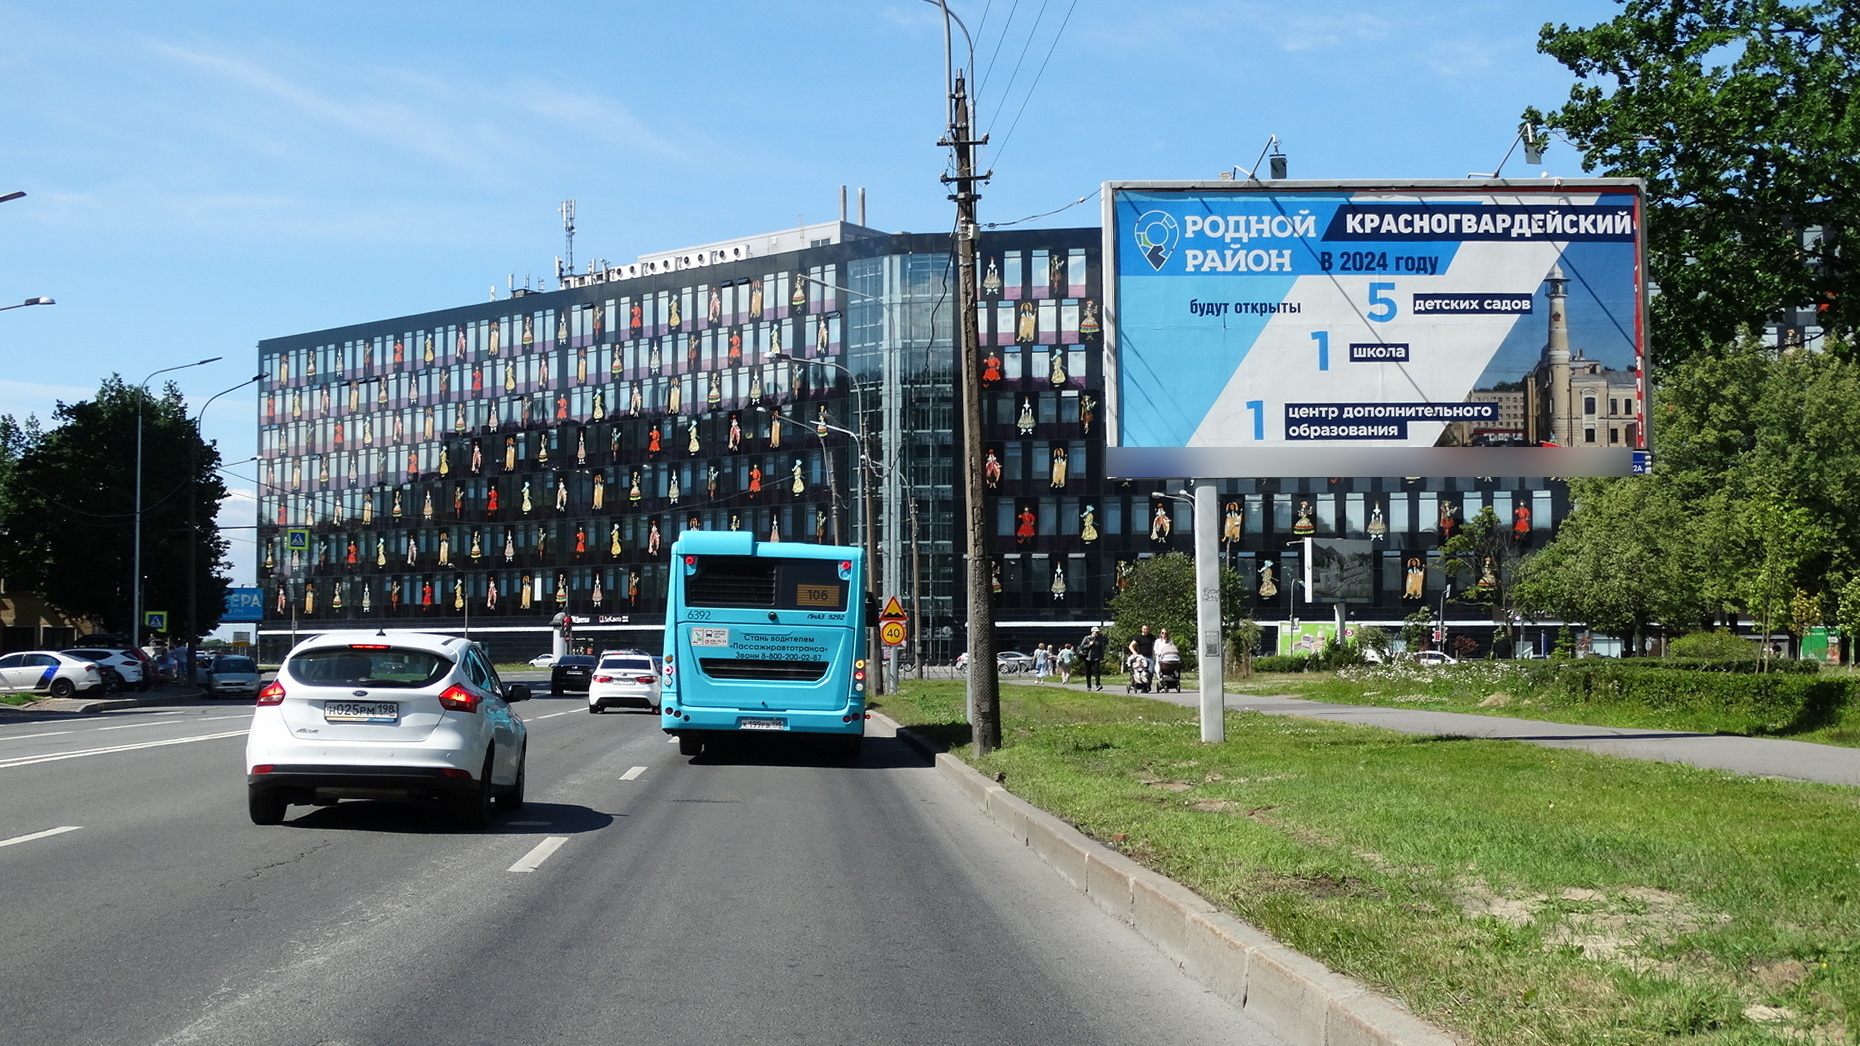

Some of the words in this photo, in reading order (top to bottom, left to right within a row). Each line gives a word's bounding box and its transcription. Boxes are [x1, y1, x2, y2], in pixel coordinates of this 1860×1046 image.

[1184, 209, 1316, 243] РОДНОЙ
[1346, 211, 1631, 237] КРАСНОГВАРДЕЙСКИЙ
[1185, 243, 1292, 272] РАЙОН
[1340, 251, 1388, 272] 2024
[1395, 255, 1439, 275] году
[1190, 299, 1229, 317] будут
[1234, 302, 1301, 317] открыты
[1366, 282, 1398, 323] 5
[1414, 299, 1479, 311] детских
[1483, 299, 1531, 311] садов
[1311, 331, 1329, 371] 1
[1353, 346, 1406, 358] школа
[1246, 400, 1264, 441] 1
[1288, 406, 1339, 420] центр
[1342, 405, 1492, 419] дополнительного
[1288, 424, 1398, 439] образования
[807, 590, 828, 600] 106
[687, 610, 711, 620] 6392
[743, 634, 769, 642] Стань
[771, 635, 814, 643] водителем
[886, 628, 900, 638] 40
[735, 651, 760, 659] Звони
[761, 652, 822, 661] 8-800-200-02-87
